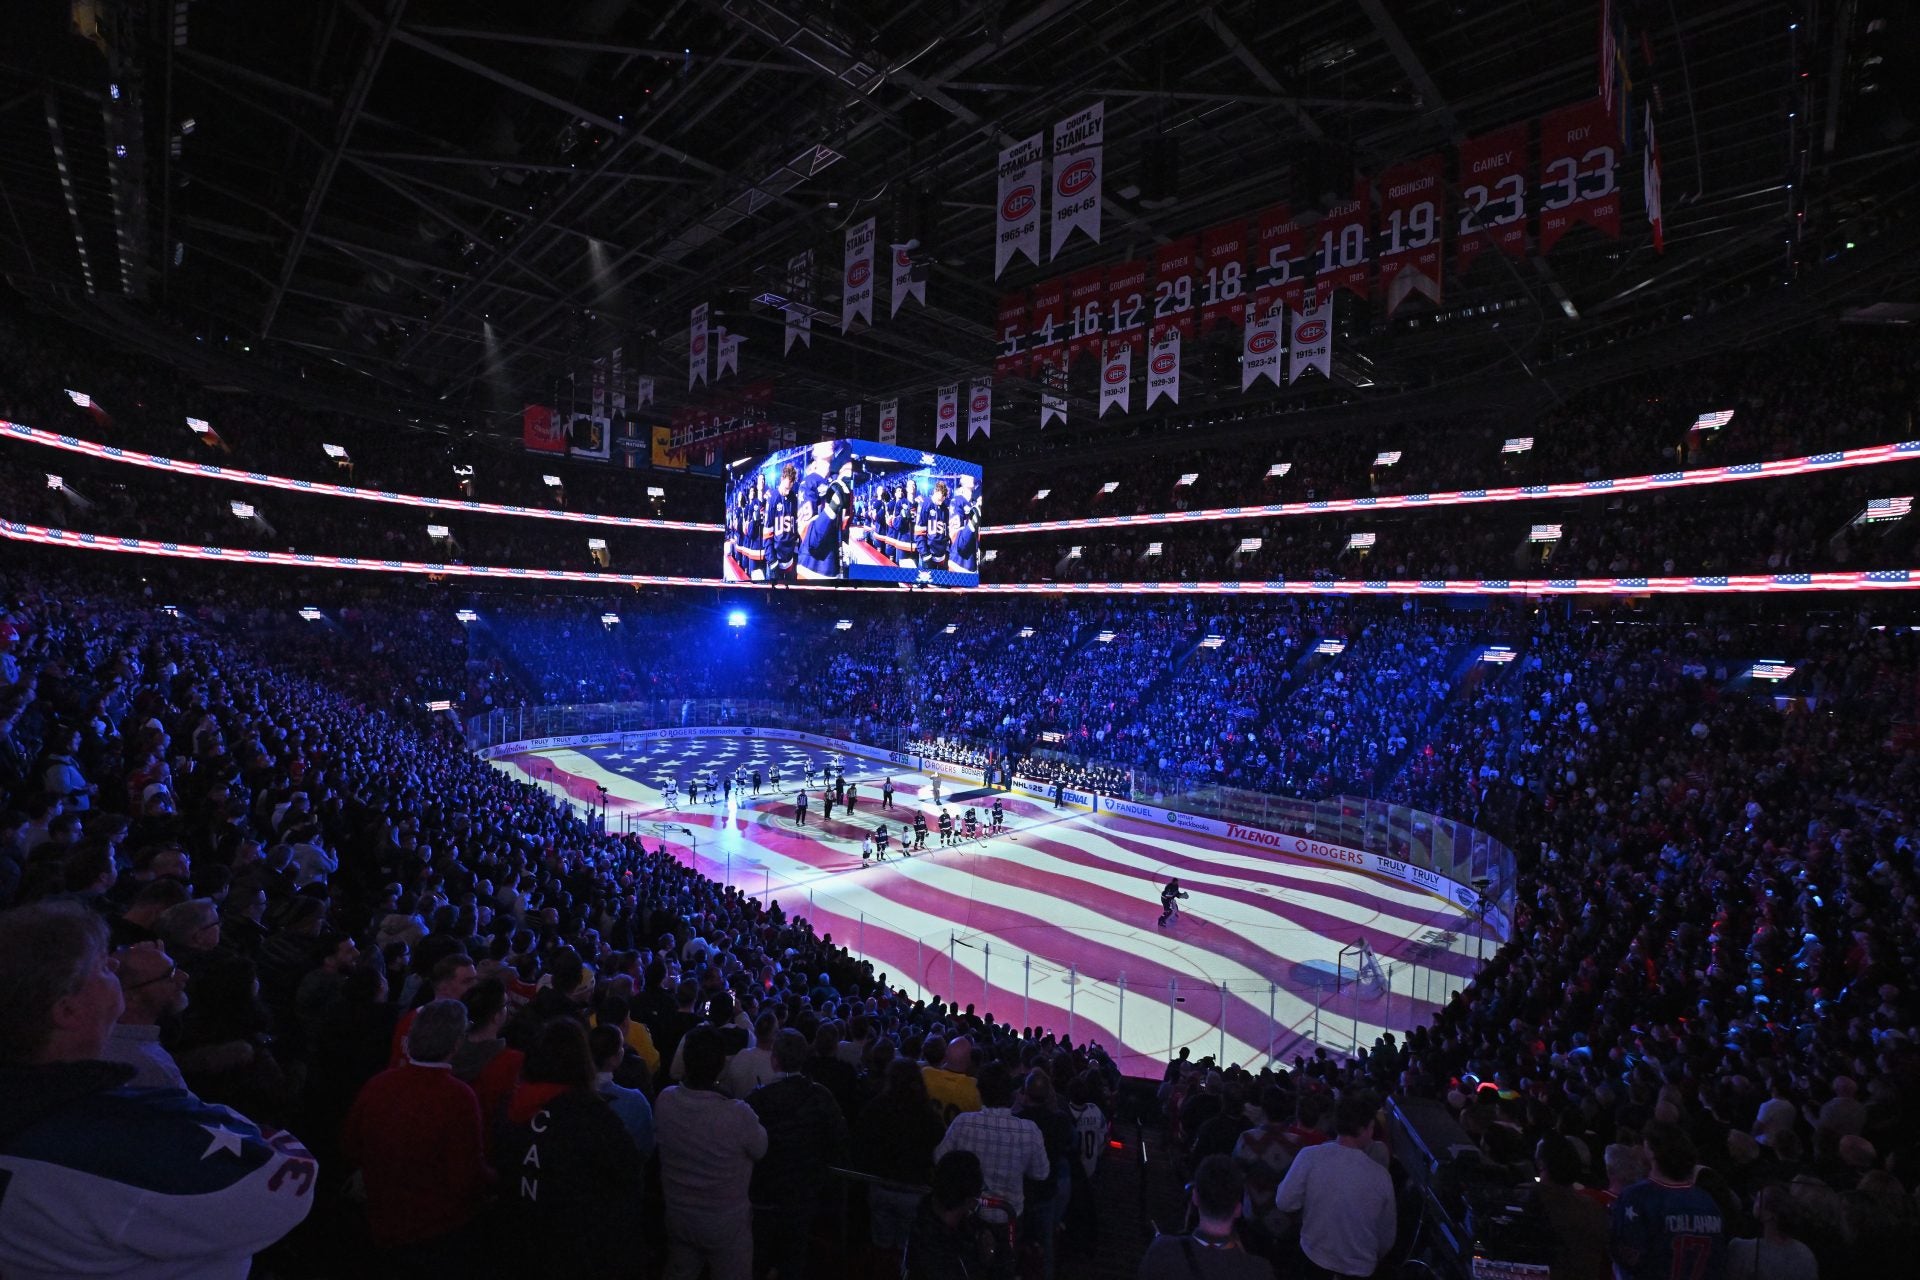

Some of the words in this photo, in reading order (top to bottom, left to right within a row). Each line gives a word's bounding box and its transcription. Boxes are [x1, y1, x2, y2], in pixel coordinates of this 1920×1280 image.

[1066, 111, 1091, 130] COUPE
[1056, 117, 1102, 151] STANLEY
[1567, 124, 1592, 143] ROY
[1009, 141, 1032, 158] COUPE
[1000, 147, 1042, 178] STANLEY
[1472, 151, 1513, 173] GAINEY
[1012, 170, 1026, 182] CUP
[1545, 145, 1615, 210] 33
[1387, 176, 1435, 200] ROBINSON
[1058, 197, 1095, 220] 1964-65
[1324, 200, 1361, 221] AFLEUR
[1459, 173, 1525, 236] 23
[1547, 217, 1566, 230] 1984
[1593, 204, 1614, 217] 1995
[1001, 222, 1035, 244] 1965-66
[1386, 201, 1435, 256] 19
[846, 229, 874, 252] STANLEY
[1211, 240, 1239, 257] SAVARD
[1319, 223, 1364, 275] 10
[1161, 256, 1188, 272] DRYDEN
[1268, 243, 1291, 287] 5
[1382, 262, 1399, 273] 1972
[1205, 261, 1241, 306] 18
[1155, 275, 1192, 320] 29
[1072, 300, 1099, 340] 16
[1110, 293, 1143, 335] 12
[1246, 306, 1281, 324] STNLEY
[1257, 320, 1269, 328] CUP
[1004, 325, 1018, 357] 5
[1040, 313, 1056, 348] 4
[1247, 357, 1276, 368] 1923-24
[1296, 346, 1326, 360] 1915-16
[1104, 387, 1126, 397] 1930-31
[1151, 376, 1175, 387] 1929-30
[931, 761, 957, 774] ROGERS
[1012, 780, 1028, 789] NHL
[1032, 784, 1043, 793] 25
[1047, 786, 1088, 805] FTENAL
[1116, 802, 1152, 818] FANDUEL
[1227, 823, 1281, 847] TYLENOL
[1311, 843, 1364, 865] ROGERS
[1377, 857, 1406, 872] TRULY
[1412, 867, 1440, 884] TRULY
[1671, 1234, 1713, 1280] 17
